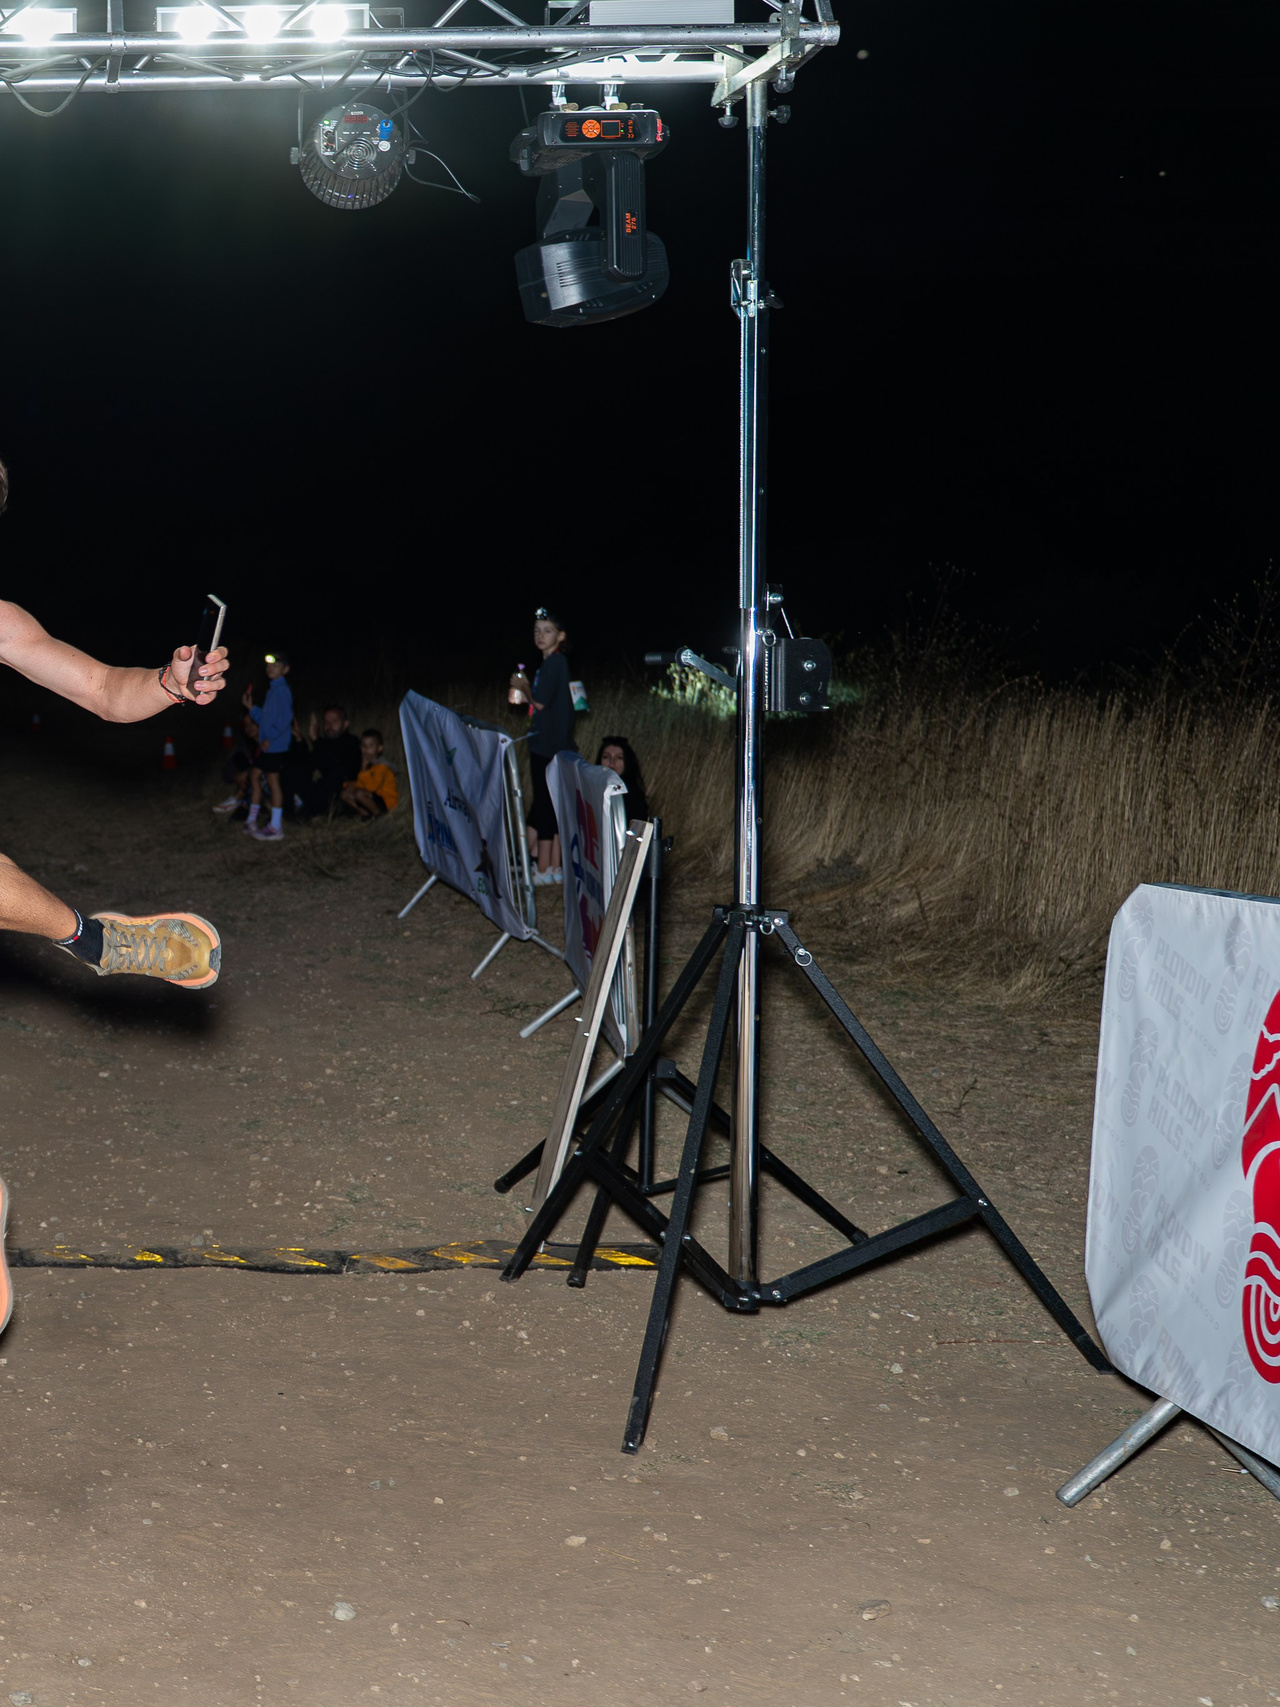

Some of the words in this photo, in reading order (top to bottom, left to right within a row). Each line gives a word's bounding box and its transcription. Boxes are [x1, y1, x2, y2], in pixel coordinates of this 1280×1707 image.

[1145, 968, 1184, 1021] HILLS
[1154, 936, 1212, 1006] PLOVDIV
[1147, 1095, 1184, 1152] HILLS
[1155, 1063, 1210, 1139] PLOVDIV
